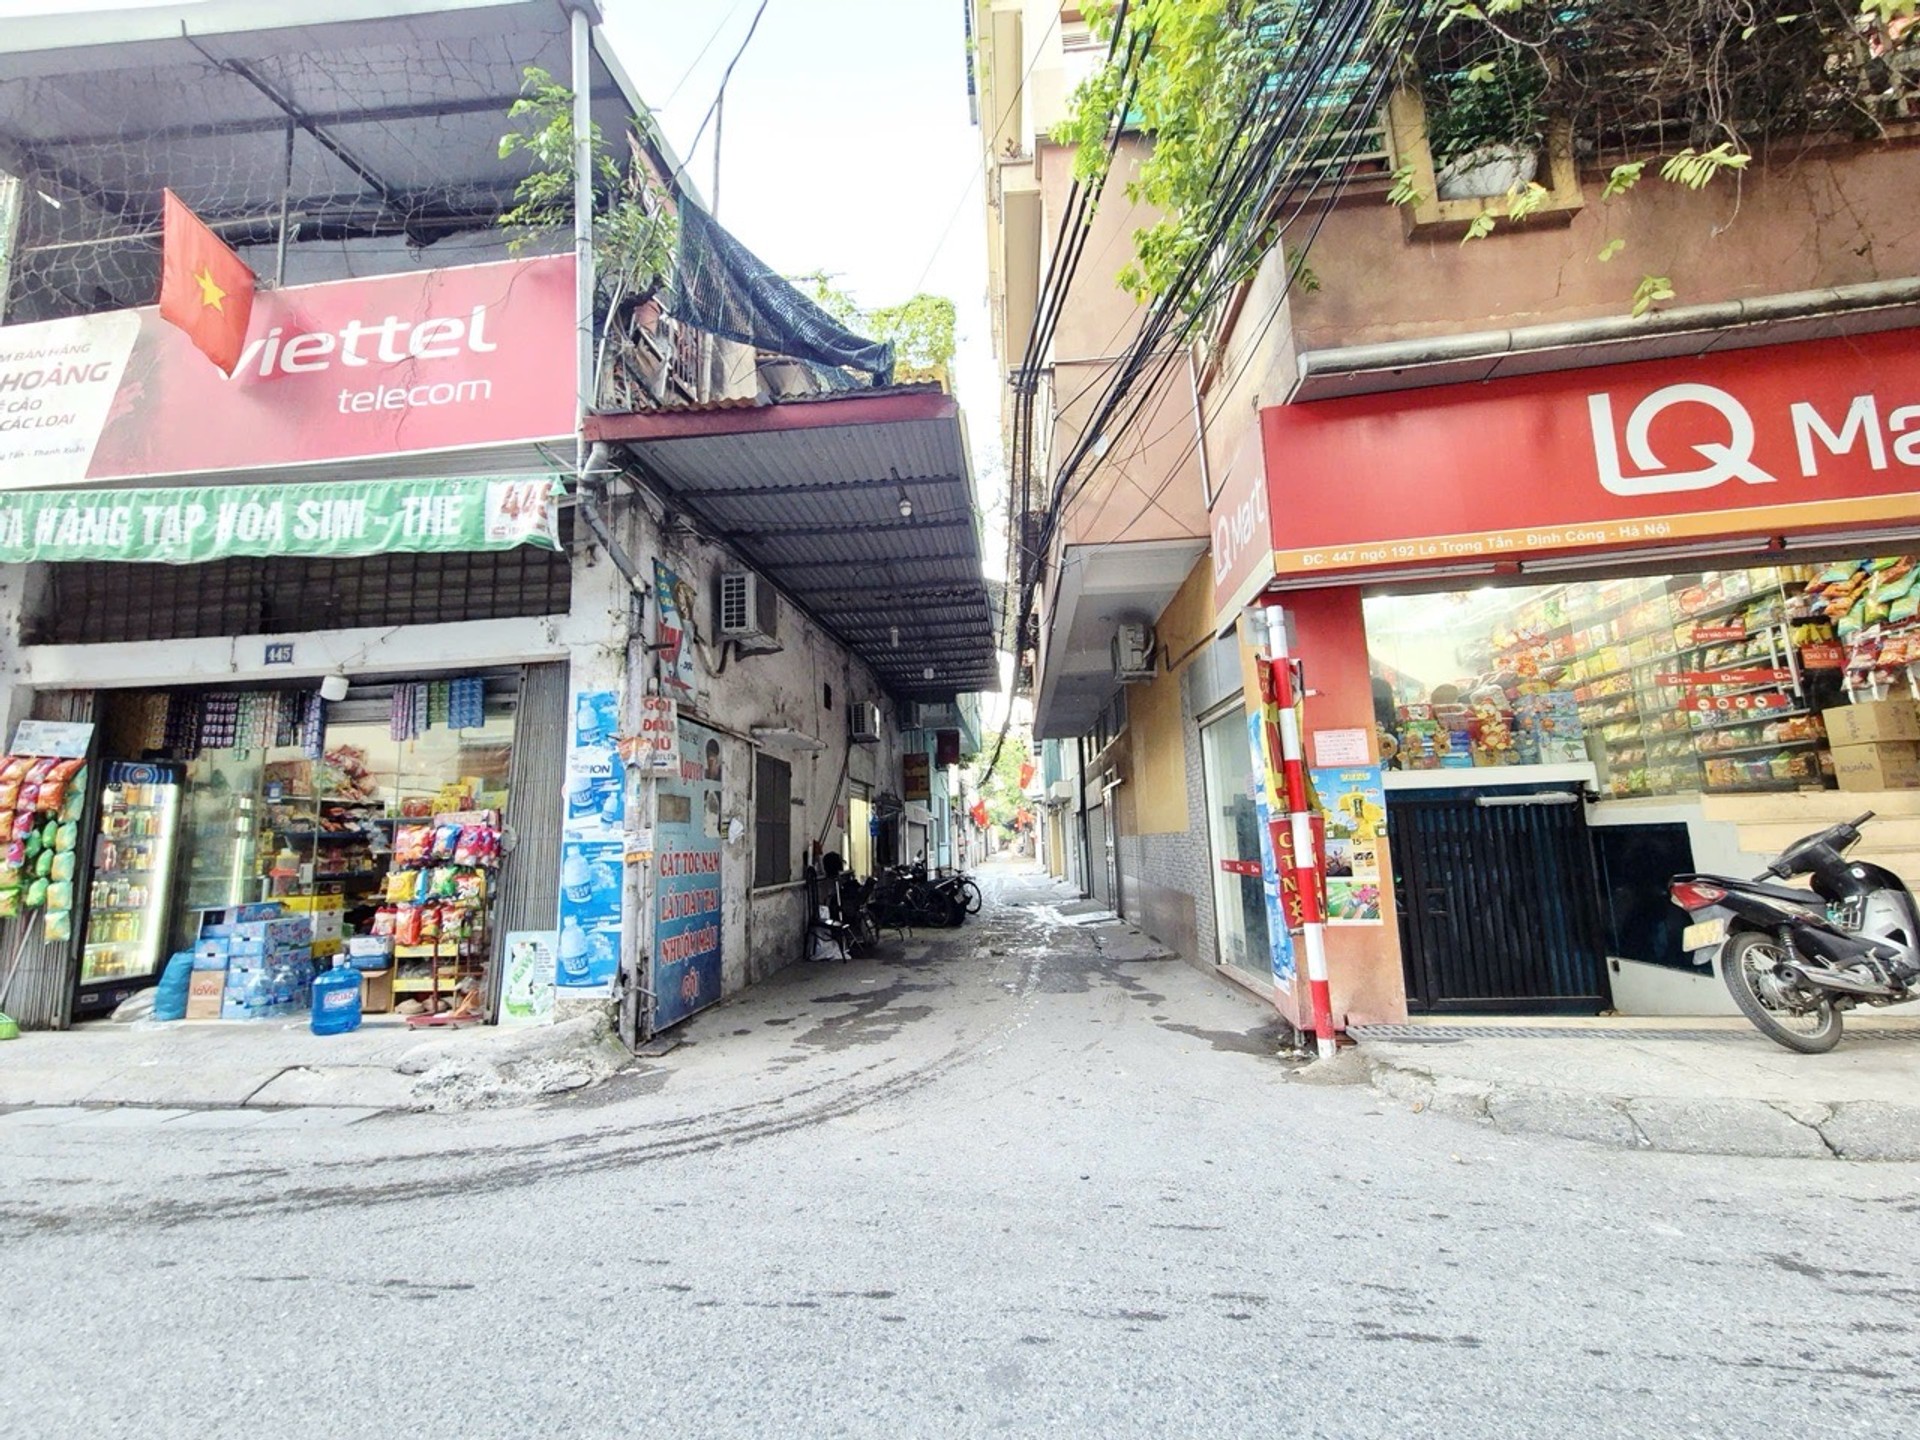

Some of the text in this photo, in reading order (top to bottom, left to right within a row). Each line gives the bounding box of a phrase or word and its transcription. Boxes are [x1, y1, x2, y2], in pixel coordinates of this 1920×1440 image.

[338, 378, 492, 414] telecom
[1587, 382, 1778, 497] LQ
[35, 497, 130, 546] HÀNG
[293, 498, 366, 541] SIM
[1331, 550, 1356, 564] 447
[1391, 545, 1416, 558] 192
[1440, 539, 1482, 559] Trọng
[1527, 532, 1560, 549] Định
[1563, 528, 1606, 546] Công
[1620, 524, 1640, 539] Hà
[1645, 520, 1671, 537] Nội
[268, 647, 291, 661] 445
[682, 846, 700, 875] TÓC
[701, 851, 720, 874] NAM
